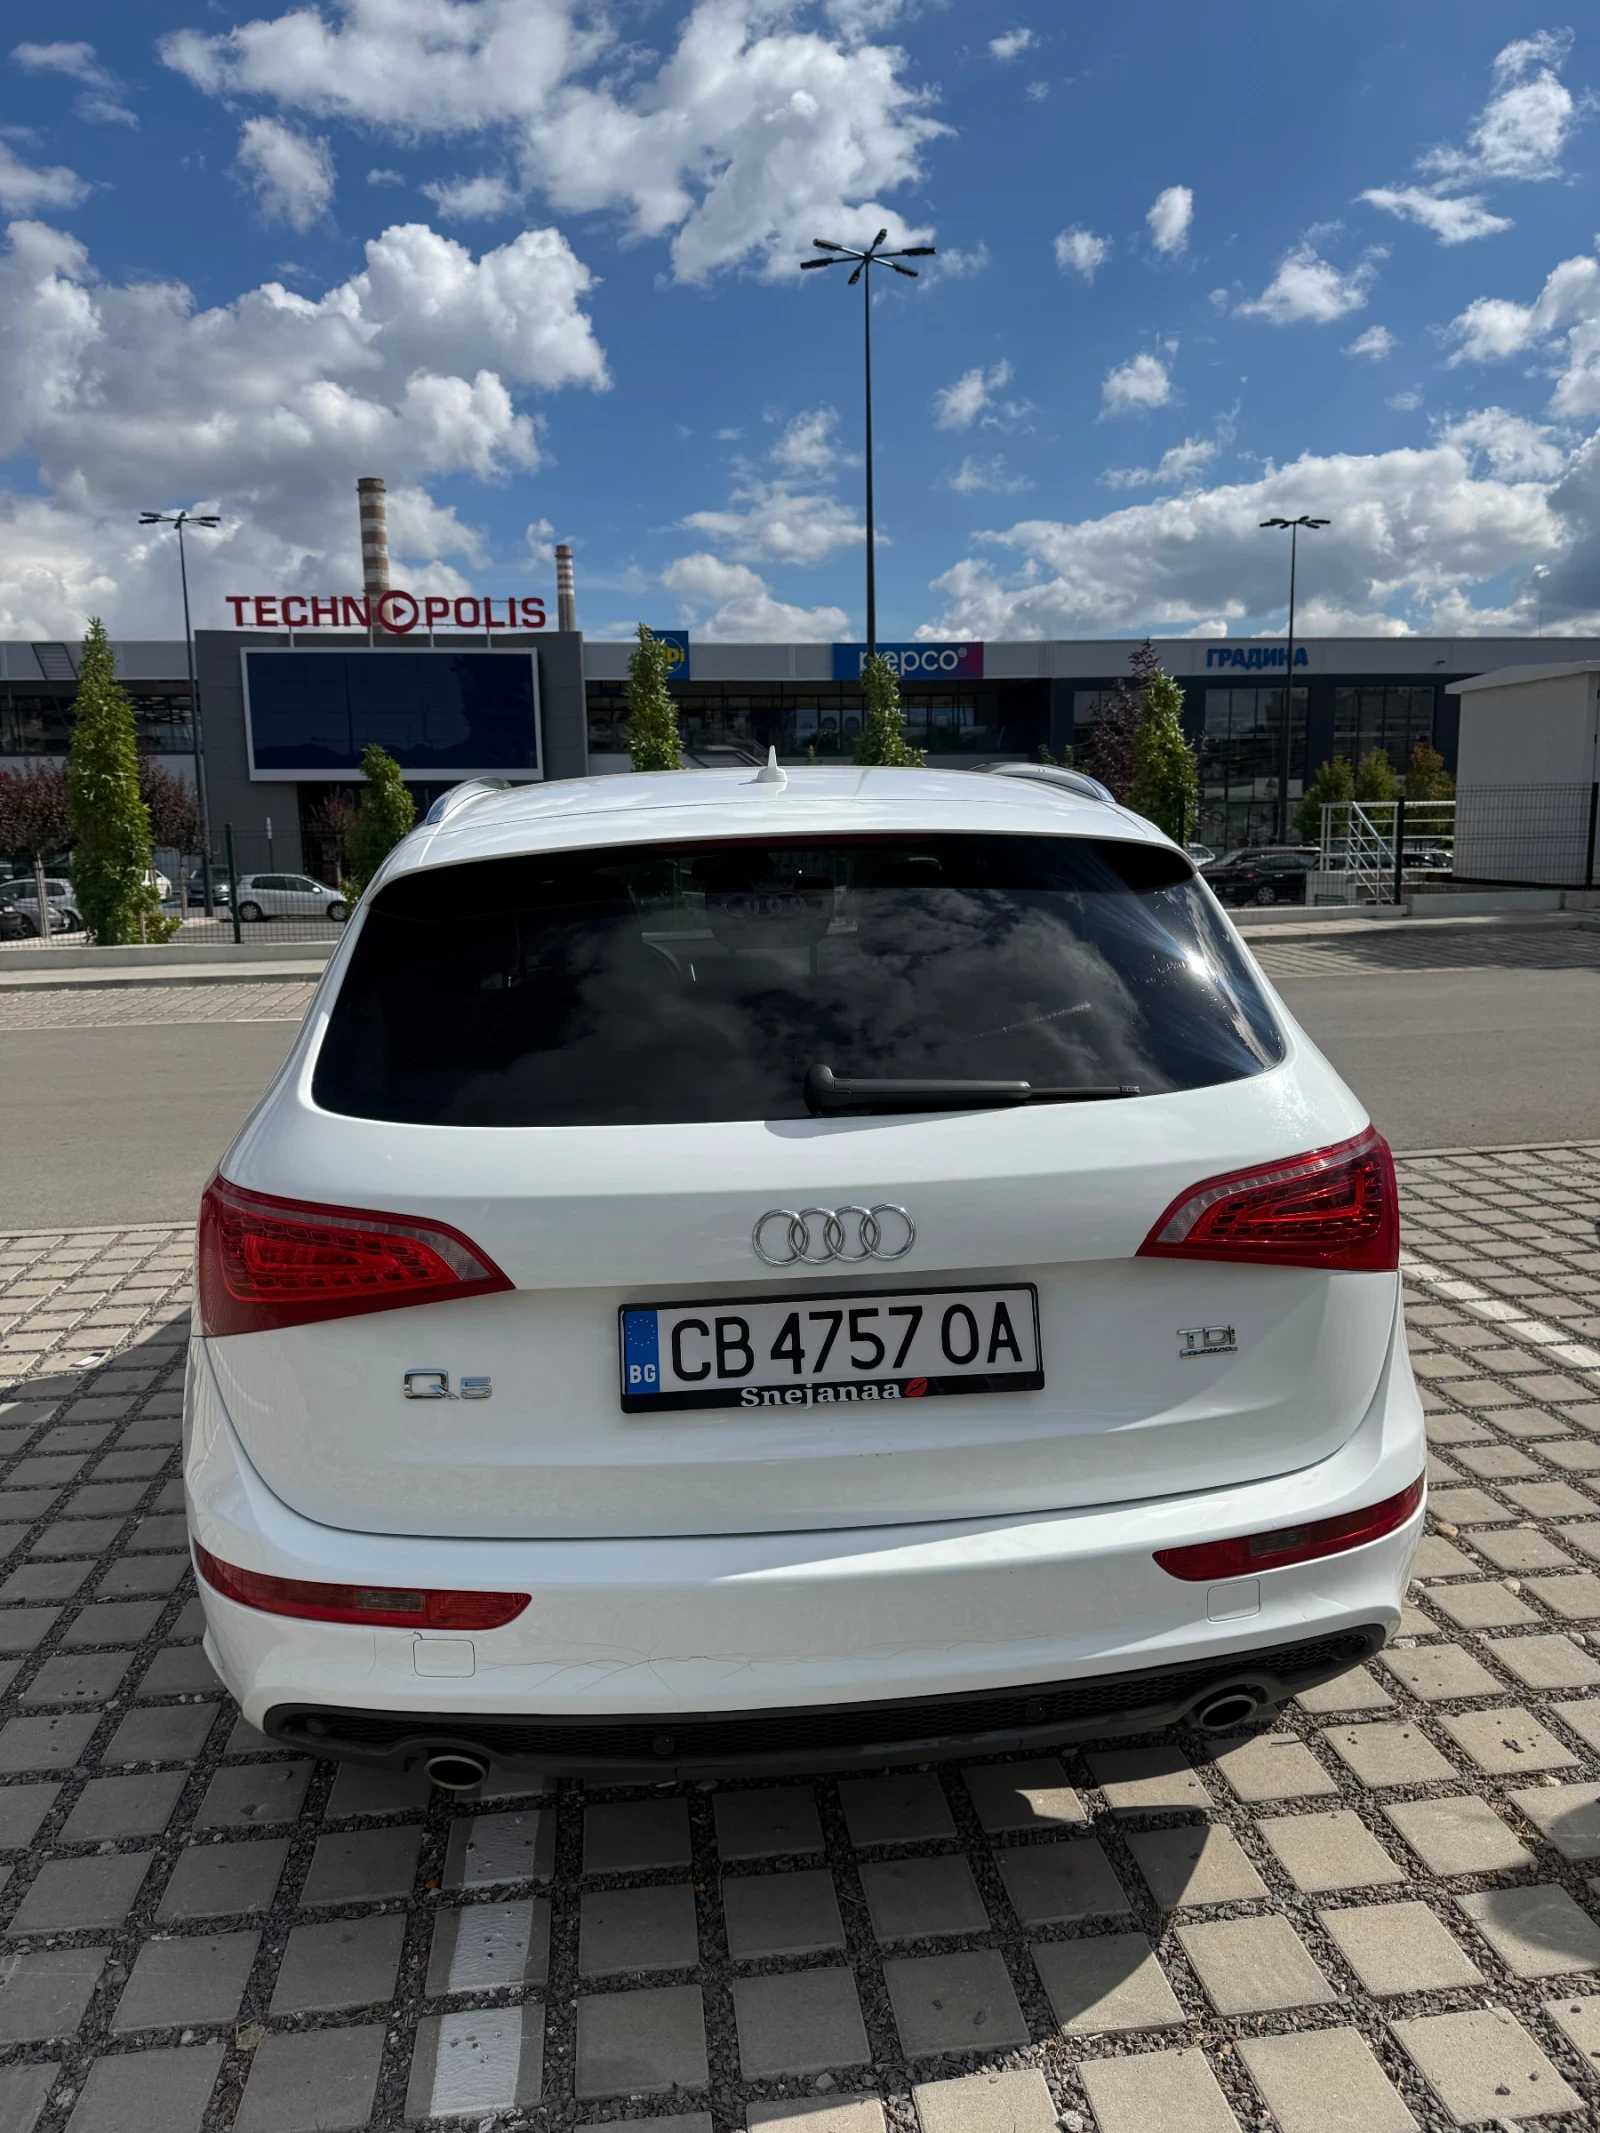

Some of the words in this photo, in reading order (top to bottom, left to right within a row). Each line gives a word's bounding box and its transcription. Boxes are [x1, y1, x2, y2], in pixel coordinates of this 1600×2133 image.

[225, 590, 547, 634] TECHNOPOLIS
[1206, 647, 1309, 670] ГРАДИНА
[671, 1315, 755, 1381] CB
[770, 1305, 923, 1375] 4757
[940, 1301, 1023, 1365] OA
[1177, 1324, 1236, 1348] TDI
[404, 1369, 493, 1400] Q5
[628, 1364, 656, 1384] BG
[740, 1379, 902, 1410] Snejanaa
